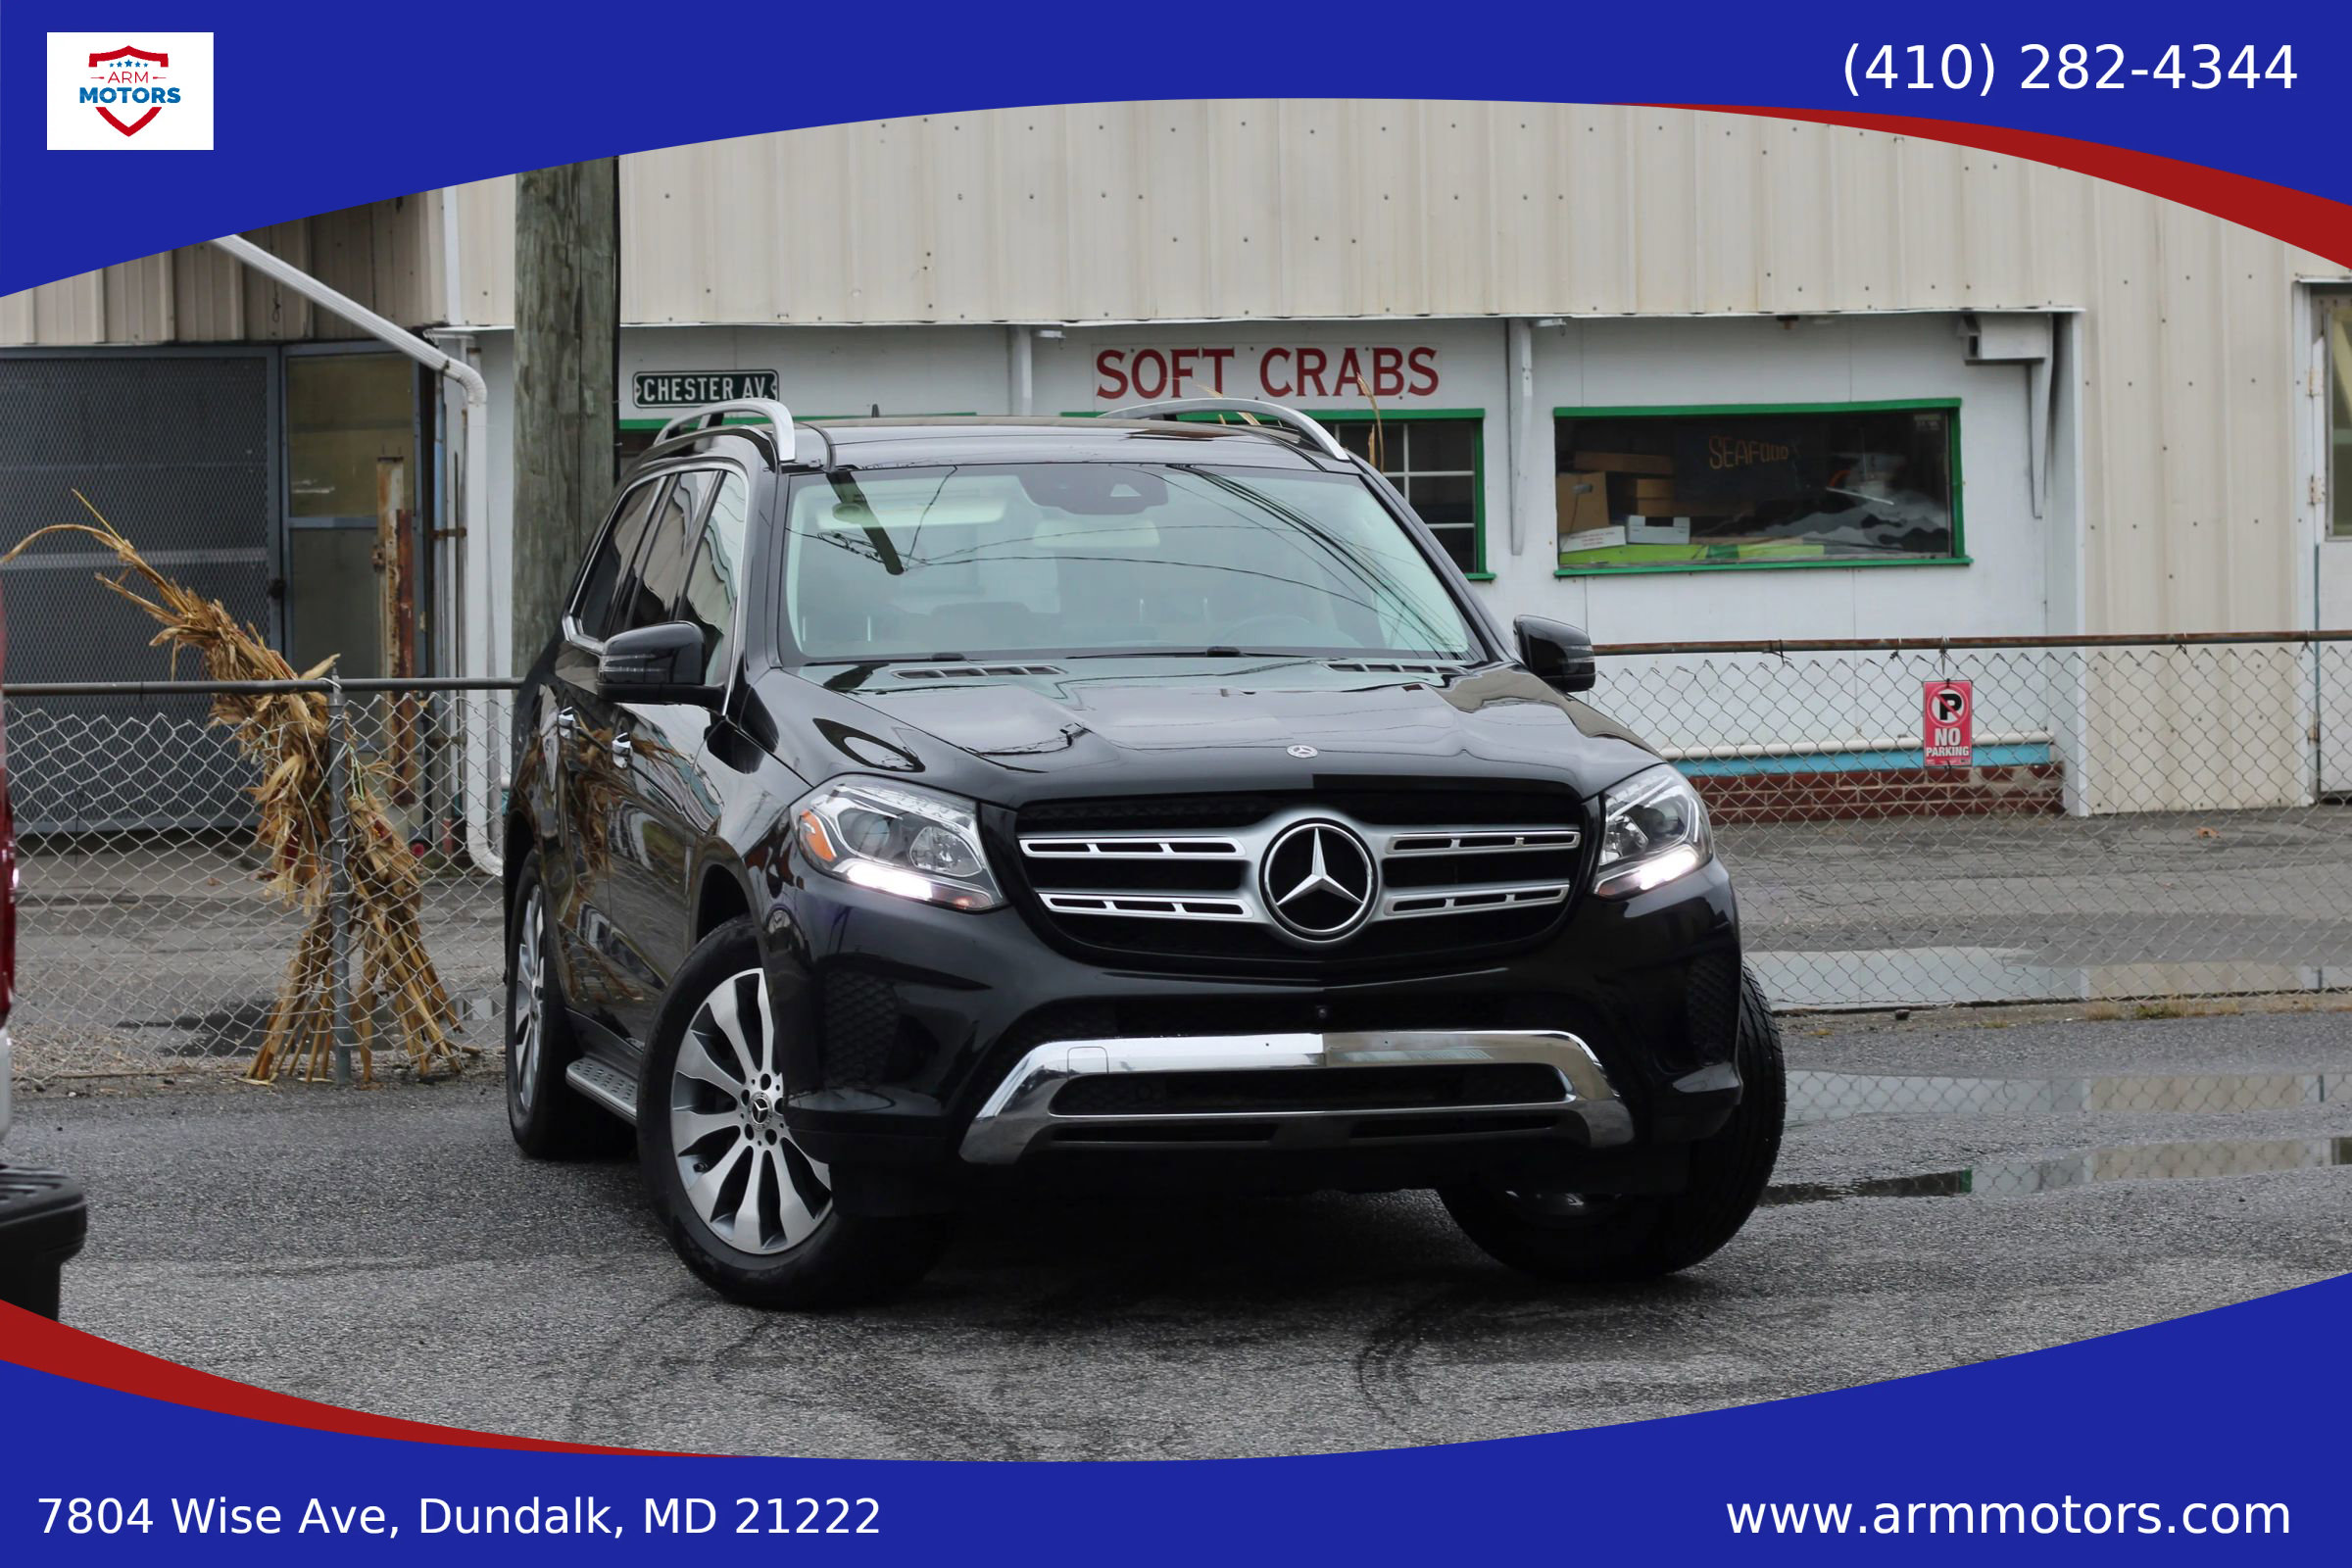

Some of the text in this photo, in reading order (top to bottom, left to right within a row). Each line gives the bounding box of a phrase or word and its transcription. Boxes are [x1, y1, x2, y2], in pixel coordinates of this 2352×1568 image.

[1096, 346, 1440, 400] SOFT CRABS
[643, 375, 769, 402] CHESTER AV.
[1935, 727, 1961, 747] NO
[1926, 746, 1970, 758] PARKING
